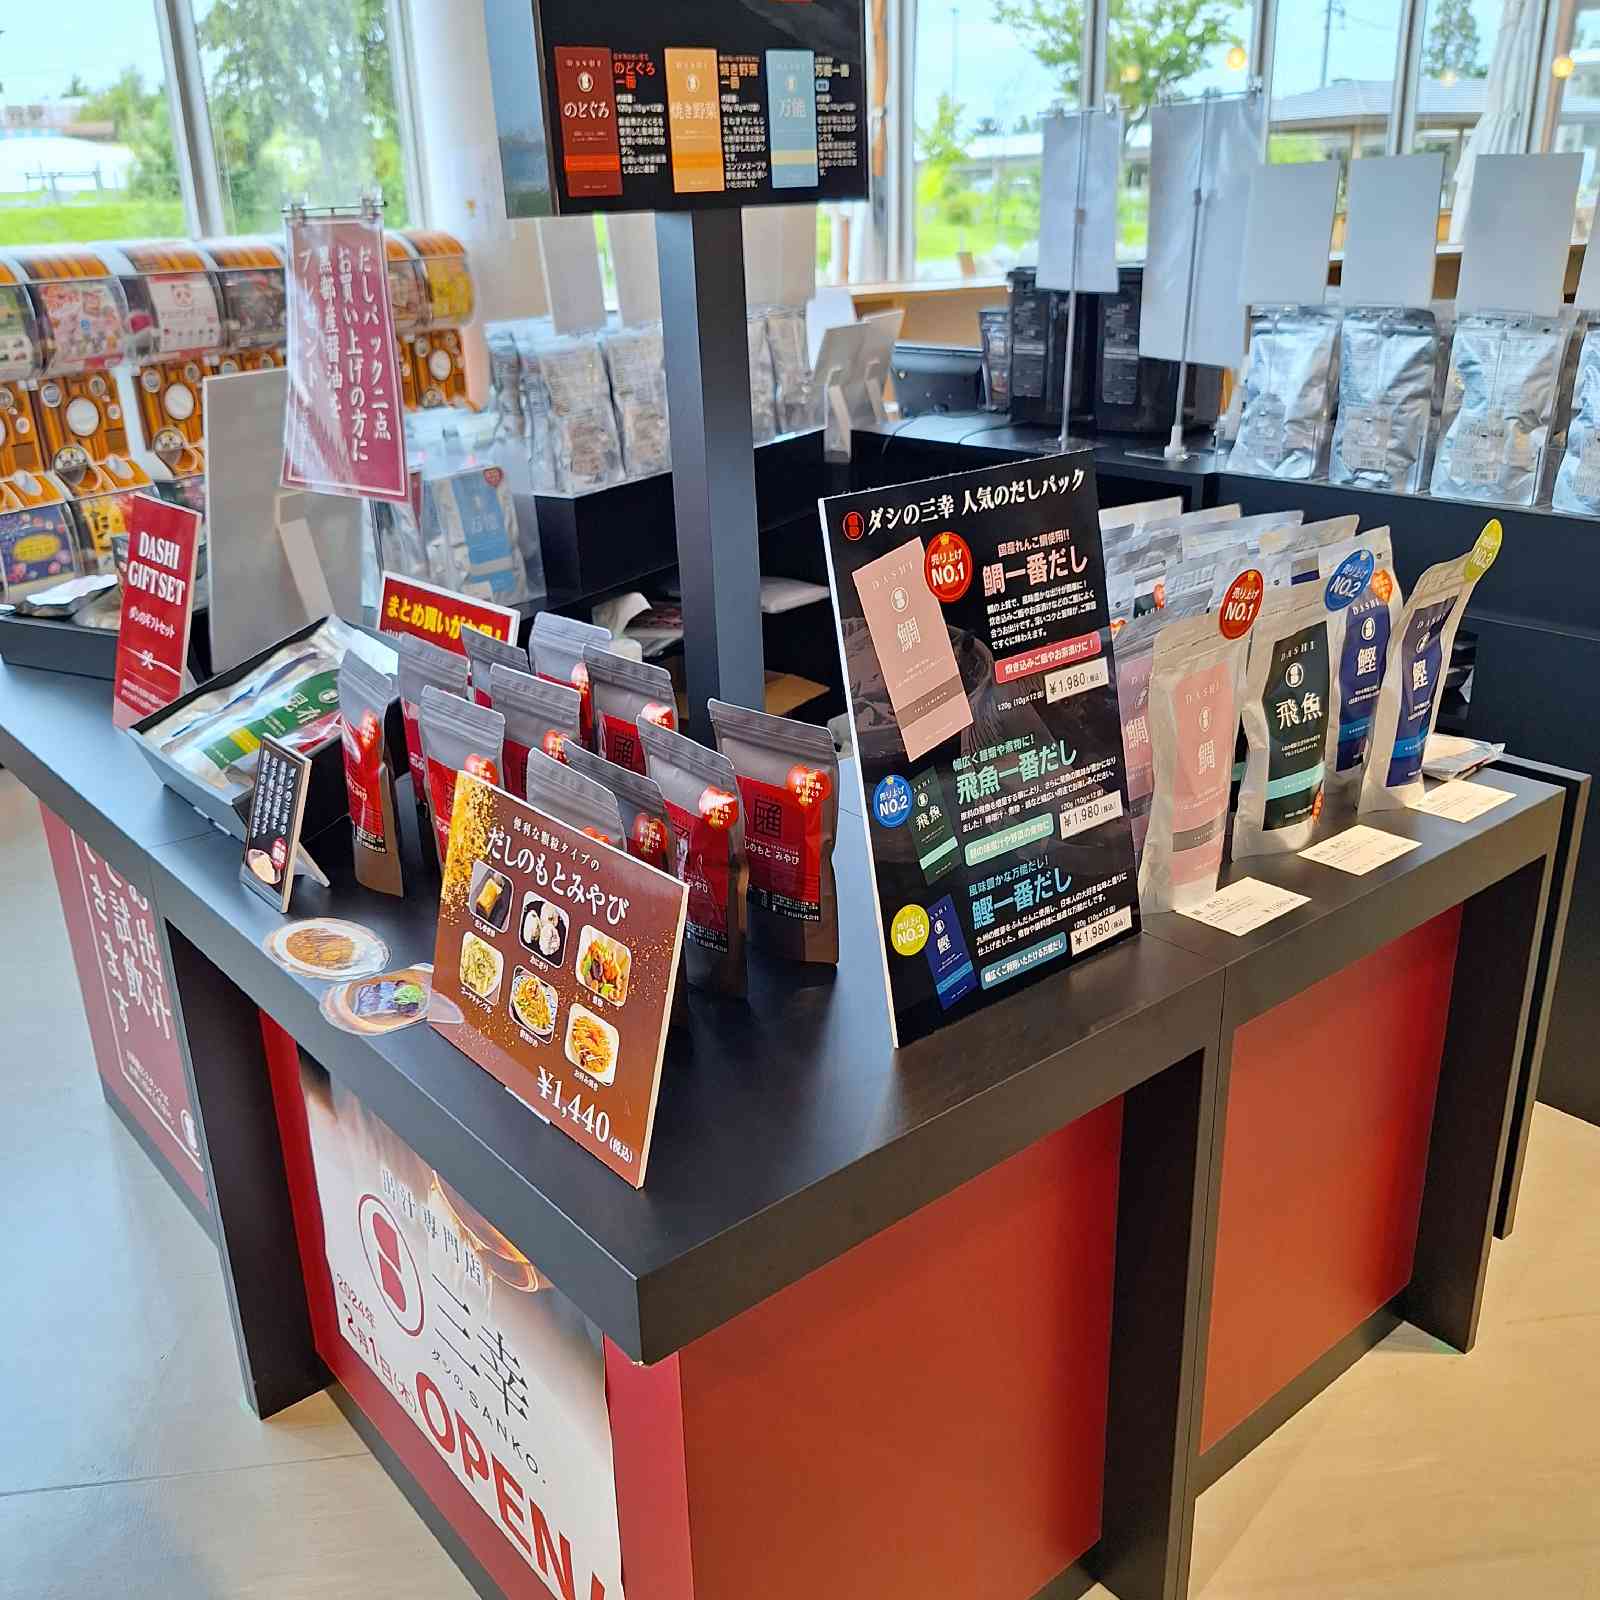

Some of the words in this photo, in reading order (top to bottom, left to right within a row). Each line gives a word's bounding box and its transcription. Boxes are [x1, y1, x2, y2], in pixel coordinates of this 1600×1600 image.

[338, 248, 368, 461] お買い上げの方に
[358, 248, 391, 440] だしパック二点
[867, 494, 955, 535] ダシの三幸
[962, 468, 1086, 516] 人気のだしパック
[138, 531, 180, 570] DASHI
[930, 548, 963, 567] 売り上げ
[931, 561, 965, 587] NO.1
[982, 545, 1088, 597] 鯛一番だし
[1330, 577, 1361, 597] NO.2
[1225, 602, 1255, 621] NO.1
[1231, 586, 1260, 600] 売り上げ
[1280, 640, 1316, 662] DASHI
[1356, 645, 1377, 676] 鰹
[1275, 691, 1324, 730] 飛魚
[956, 739, 1077, 805] 飛魚一番だし
[879, 795, 908, 817] NO.2
[1063, 803, 1100, 828] ¥1,980
[744, 840, 771, 858] しのもと
[486, 826, 630, 925] だしのもとみやび
[968, 855, 1049, 897] 風味豊かな万能だし!
[971, 867, 1072, 931] 鰹一番だし
[84, 841, 130, 1033] きます
[105, 861, 152, 1016] 試飲
[896, 924, 925, 946] NO.3
[1074, 920, 1110, 947] ¥1,980
[537, 1065, 610, 1143] ¥1,440
[608, 1136, 634, 1164] (税込)
[336, 1271, 375, 1329] 2024年
[343, 1302, 417, 1415] 2月1日(木)
